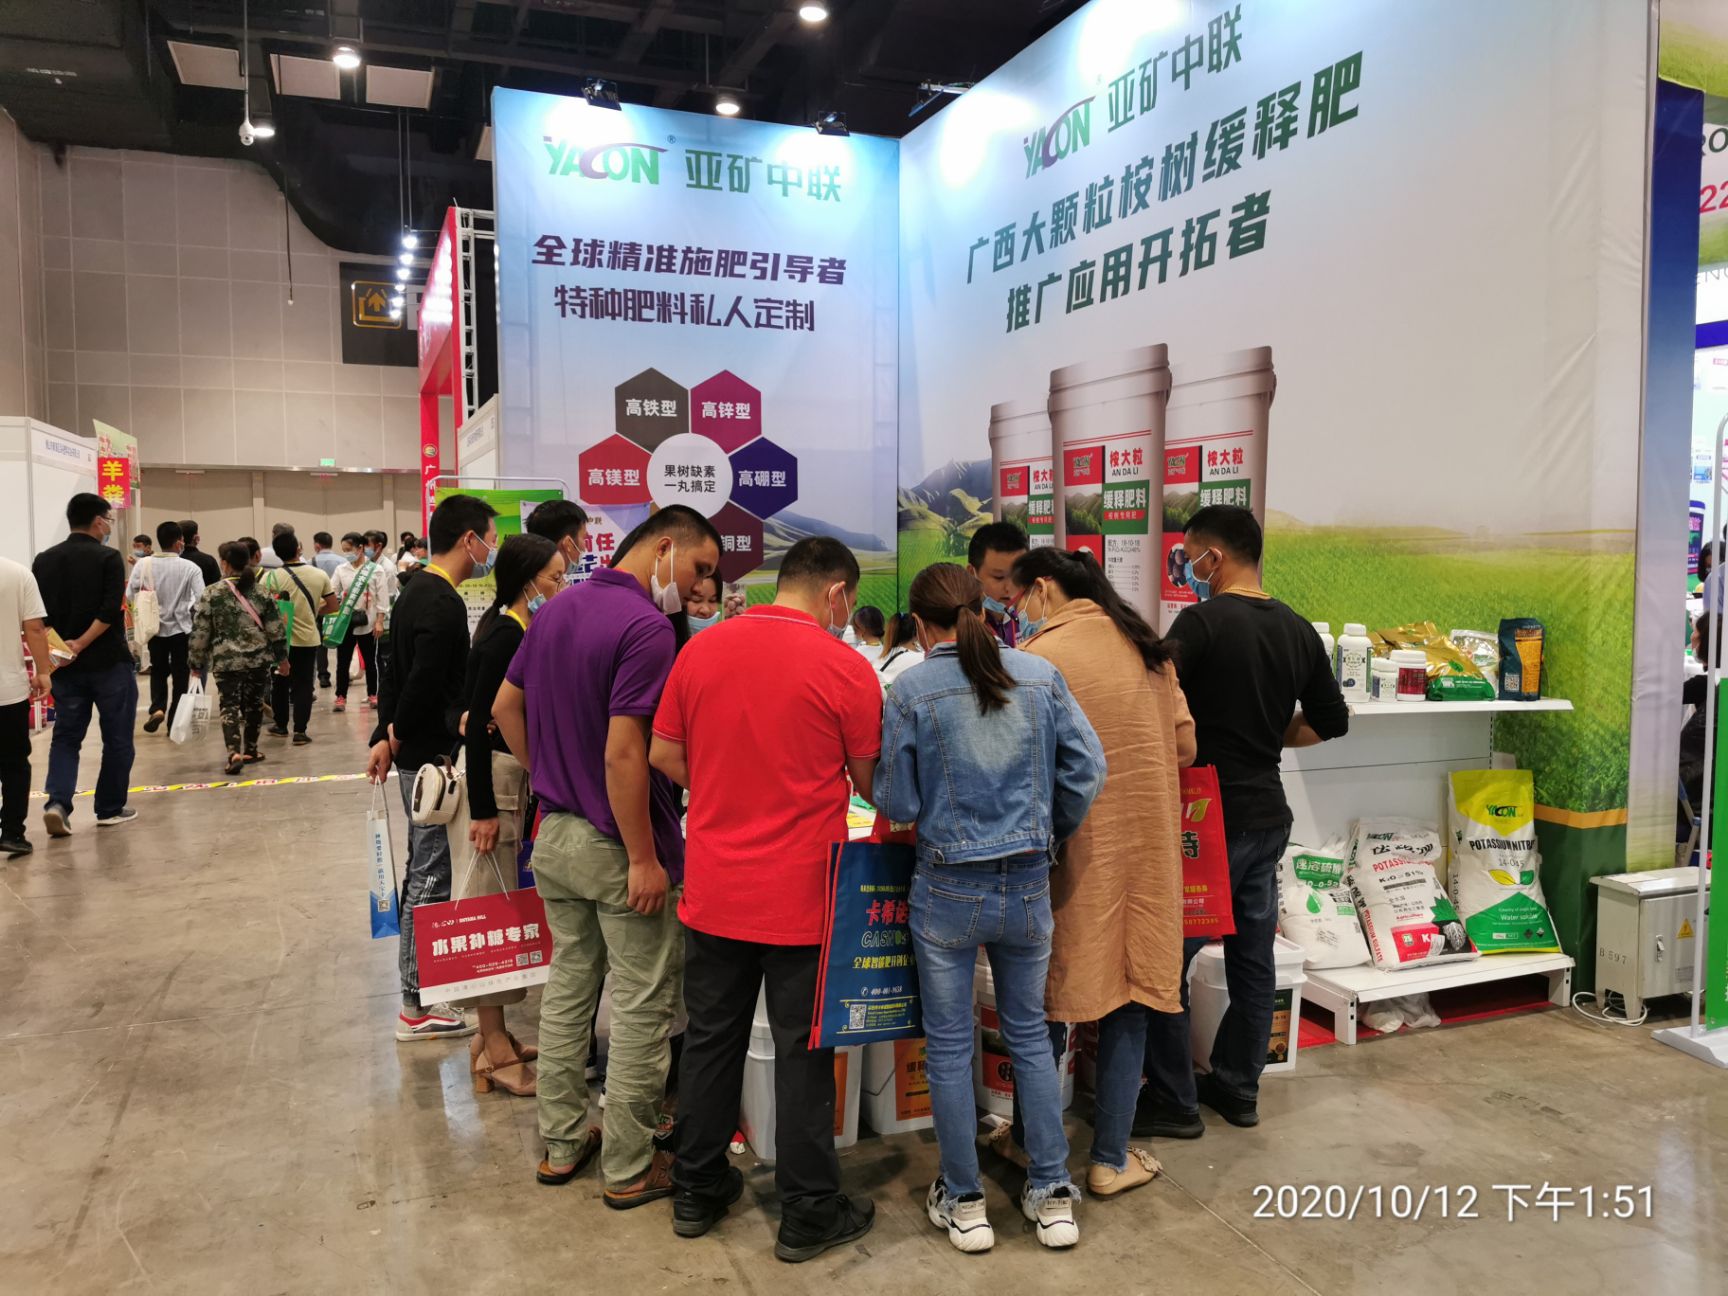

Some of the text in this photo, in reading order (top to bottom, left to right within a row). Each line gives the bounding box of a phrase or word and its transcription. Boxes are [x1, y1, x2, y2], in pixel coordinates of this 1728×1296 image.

[1107, 3, 1242, 133] 亚矿中联
[1023, 96, 1096, 179] YACON
[685, 147, 841, 202] 亚矿中联
[967, 50, 1363, 285] 广西大颗粒桉树缓释肥
[531, 234, 847, 286] 全球精准施肥引导者
[1006, 189, 1271, 333] 推广应用开拓者
[554, 284, 815, 332] 特种肥料私人定制
[625, 398, 677, 418] 高铁型
[701, 401, 751, 419] 高锌型
[1110, 448, 1143, 467] 桉大粒
[1207, 448, 1243, 467] 桉大粒
[587, 468, 641, 487] 高镁型
[664, 464, 716, 478] 果树缺素
[738, 470, 787, 488] 高硼型
[1133, 467, 1138, 475] LI
[1221, 467, 1231, 475] DA
[102, 460, 125, 505] 羊粪
[664, 480, 716, 493] 一丸搞定
[1103, 488, 1146, 509] 缓释肥料
[1200, 486, 1247, 507] 缓释肥料
[720, 534, 752, 552] 铜型
[1486, 804, 1518, 818] YACON
